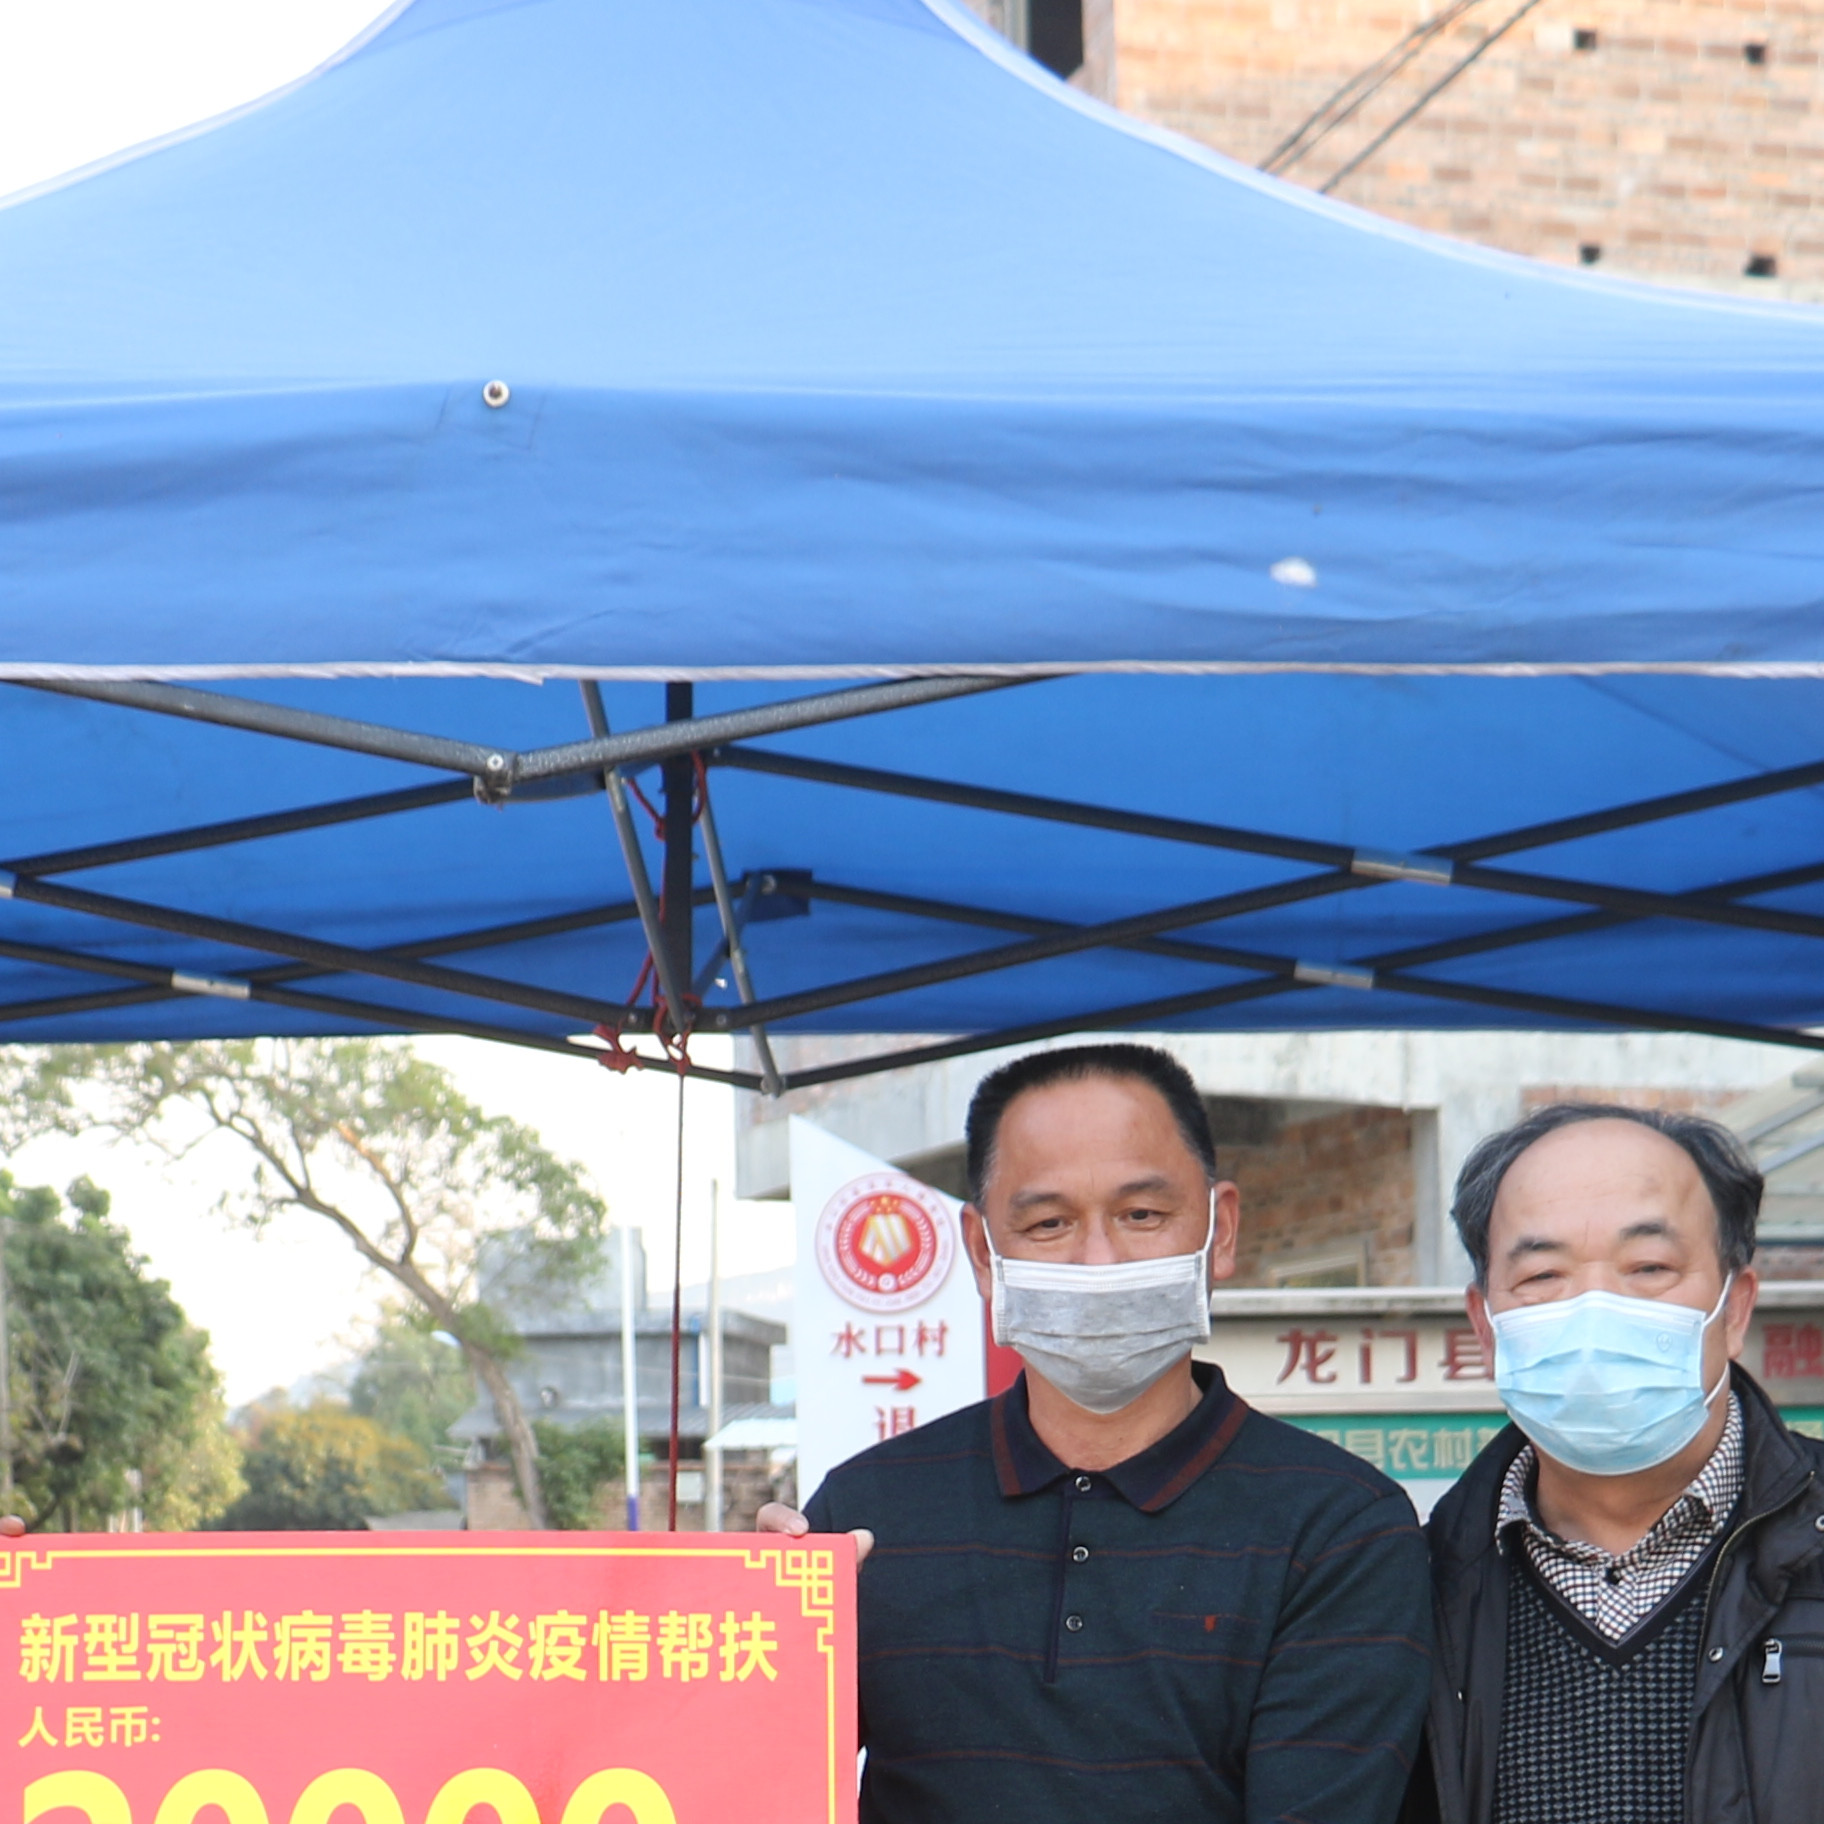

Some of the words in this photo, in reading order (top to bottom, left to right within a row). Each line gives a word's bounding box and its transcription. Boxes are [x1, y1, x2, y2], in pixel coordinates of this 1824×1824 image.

[831, 1320, 948, 1358] 水口村
[1275, 1326, 1495, 1385] 龙门县
[18, 1609, 779, 1684] 新型冠状病毒肺炎疫情帮扶
[18, 1706, 162, 1748] 人民币:
